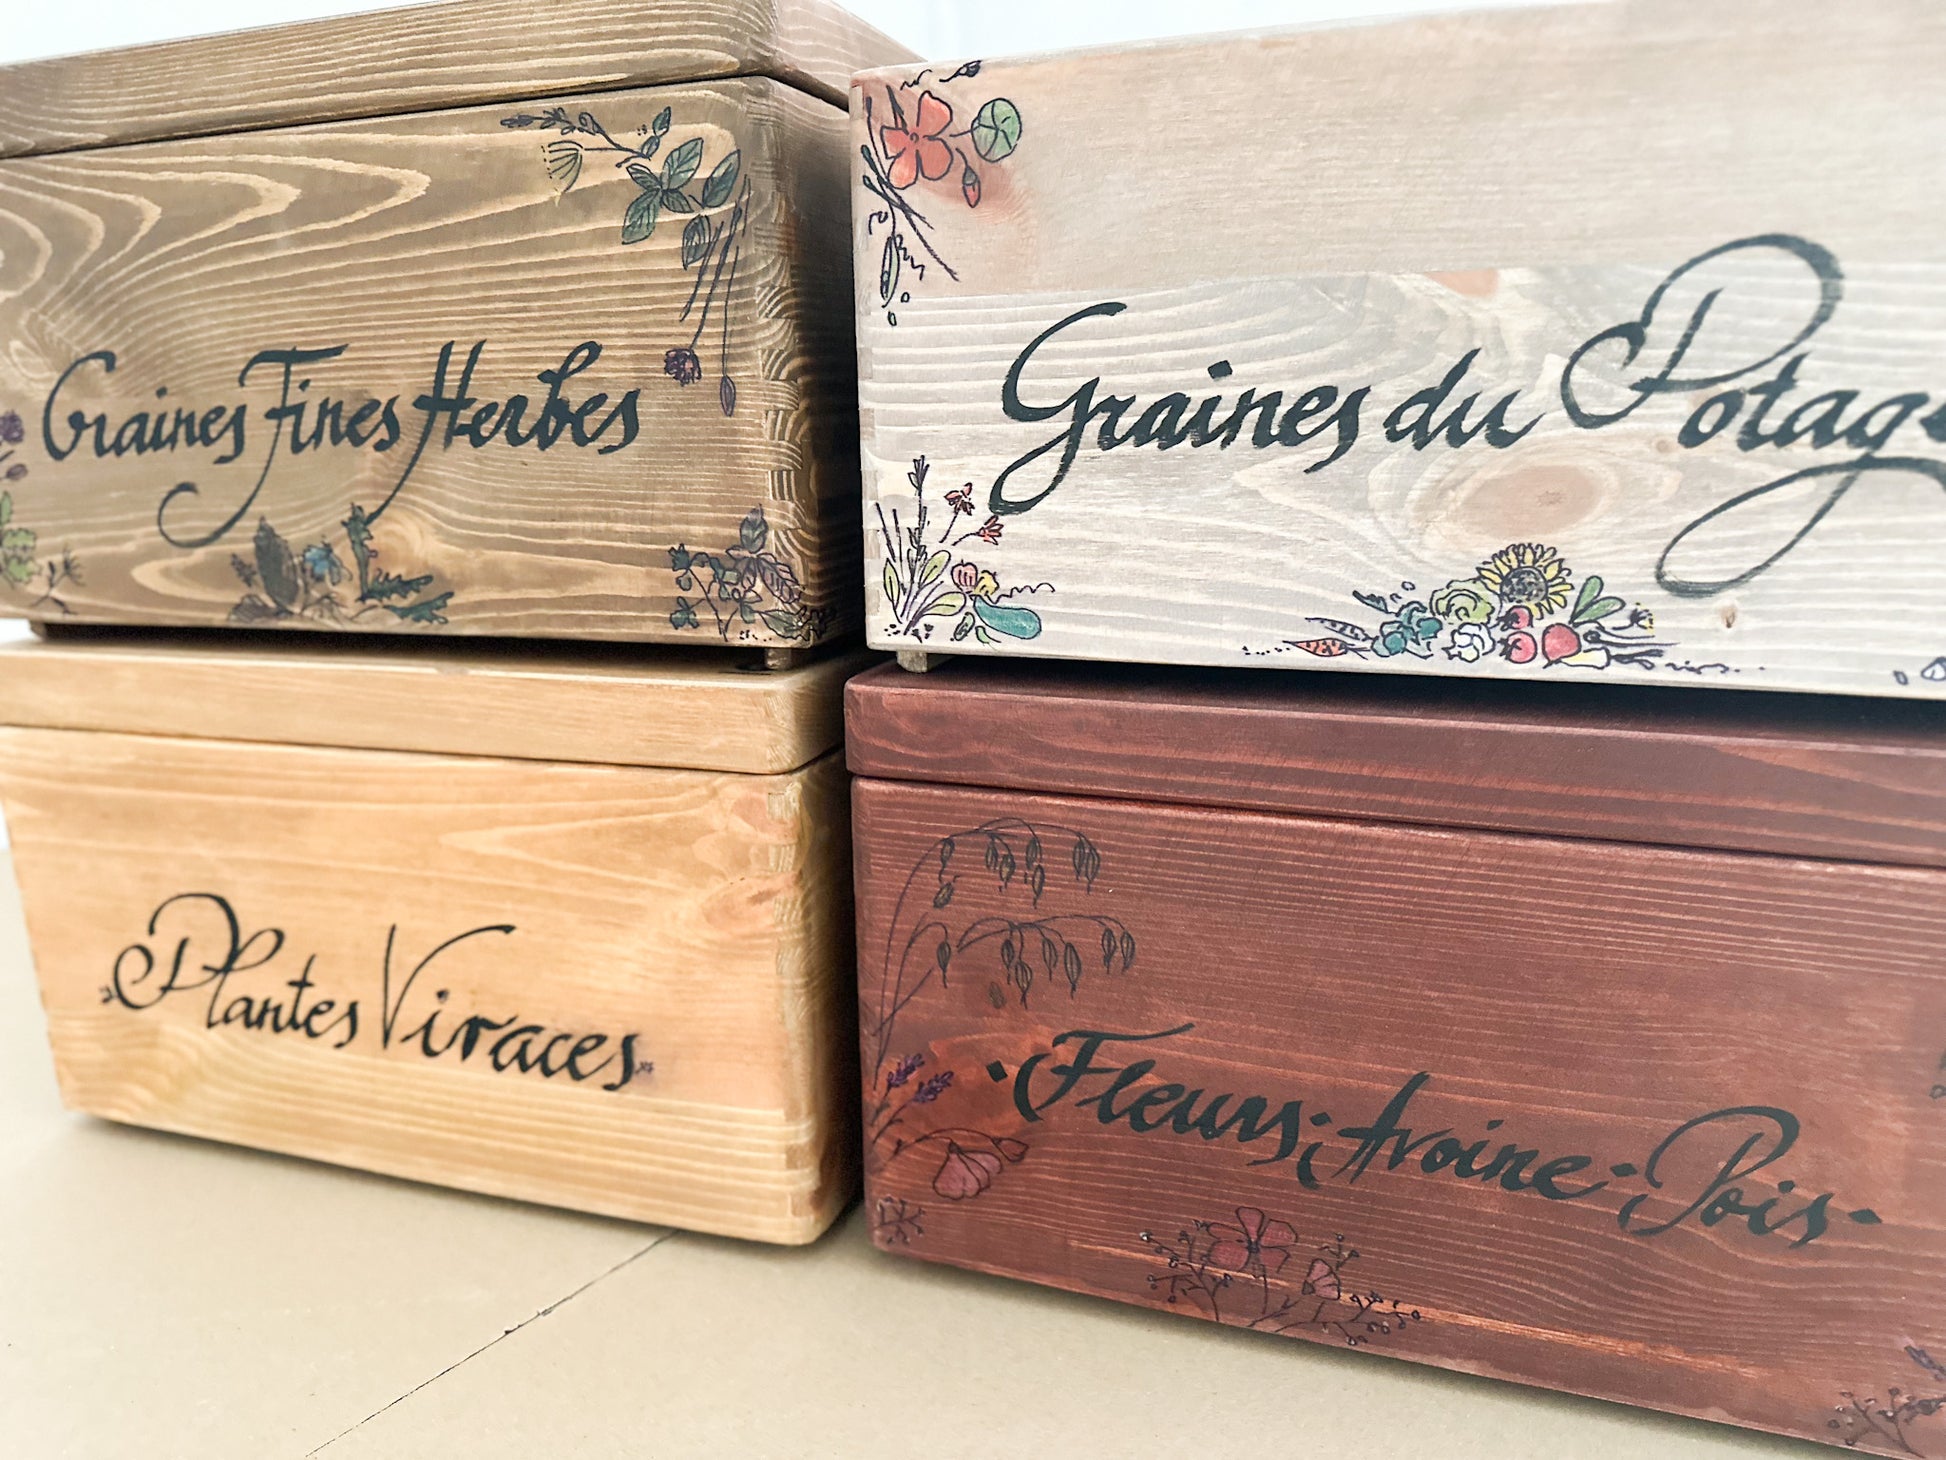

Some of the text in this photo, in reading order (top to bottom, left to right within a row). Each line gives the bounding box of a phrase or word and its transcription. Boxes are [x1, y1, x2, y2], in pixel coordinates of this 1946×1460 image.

[42, 338, 642, 549] Graines Fines Herbes
[987, 301, 1372, 516] Graines
[1363, 349, 1542, 451] du
[112, 892, 360, 1050] Plantes
[1616, 1105, 1835, 1249] Pois
